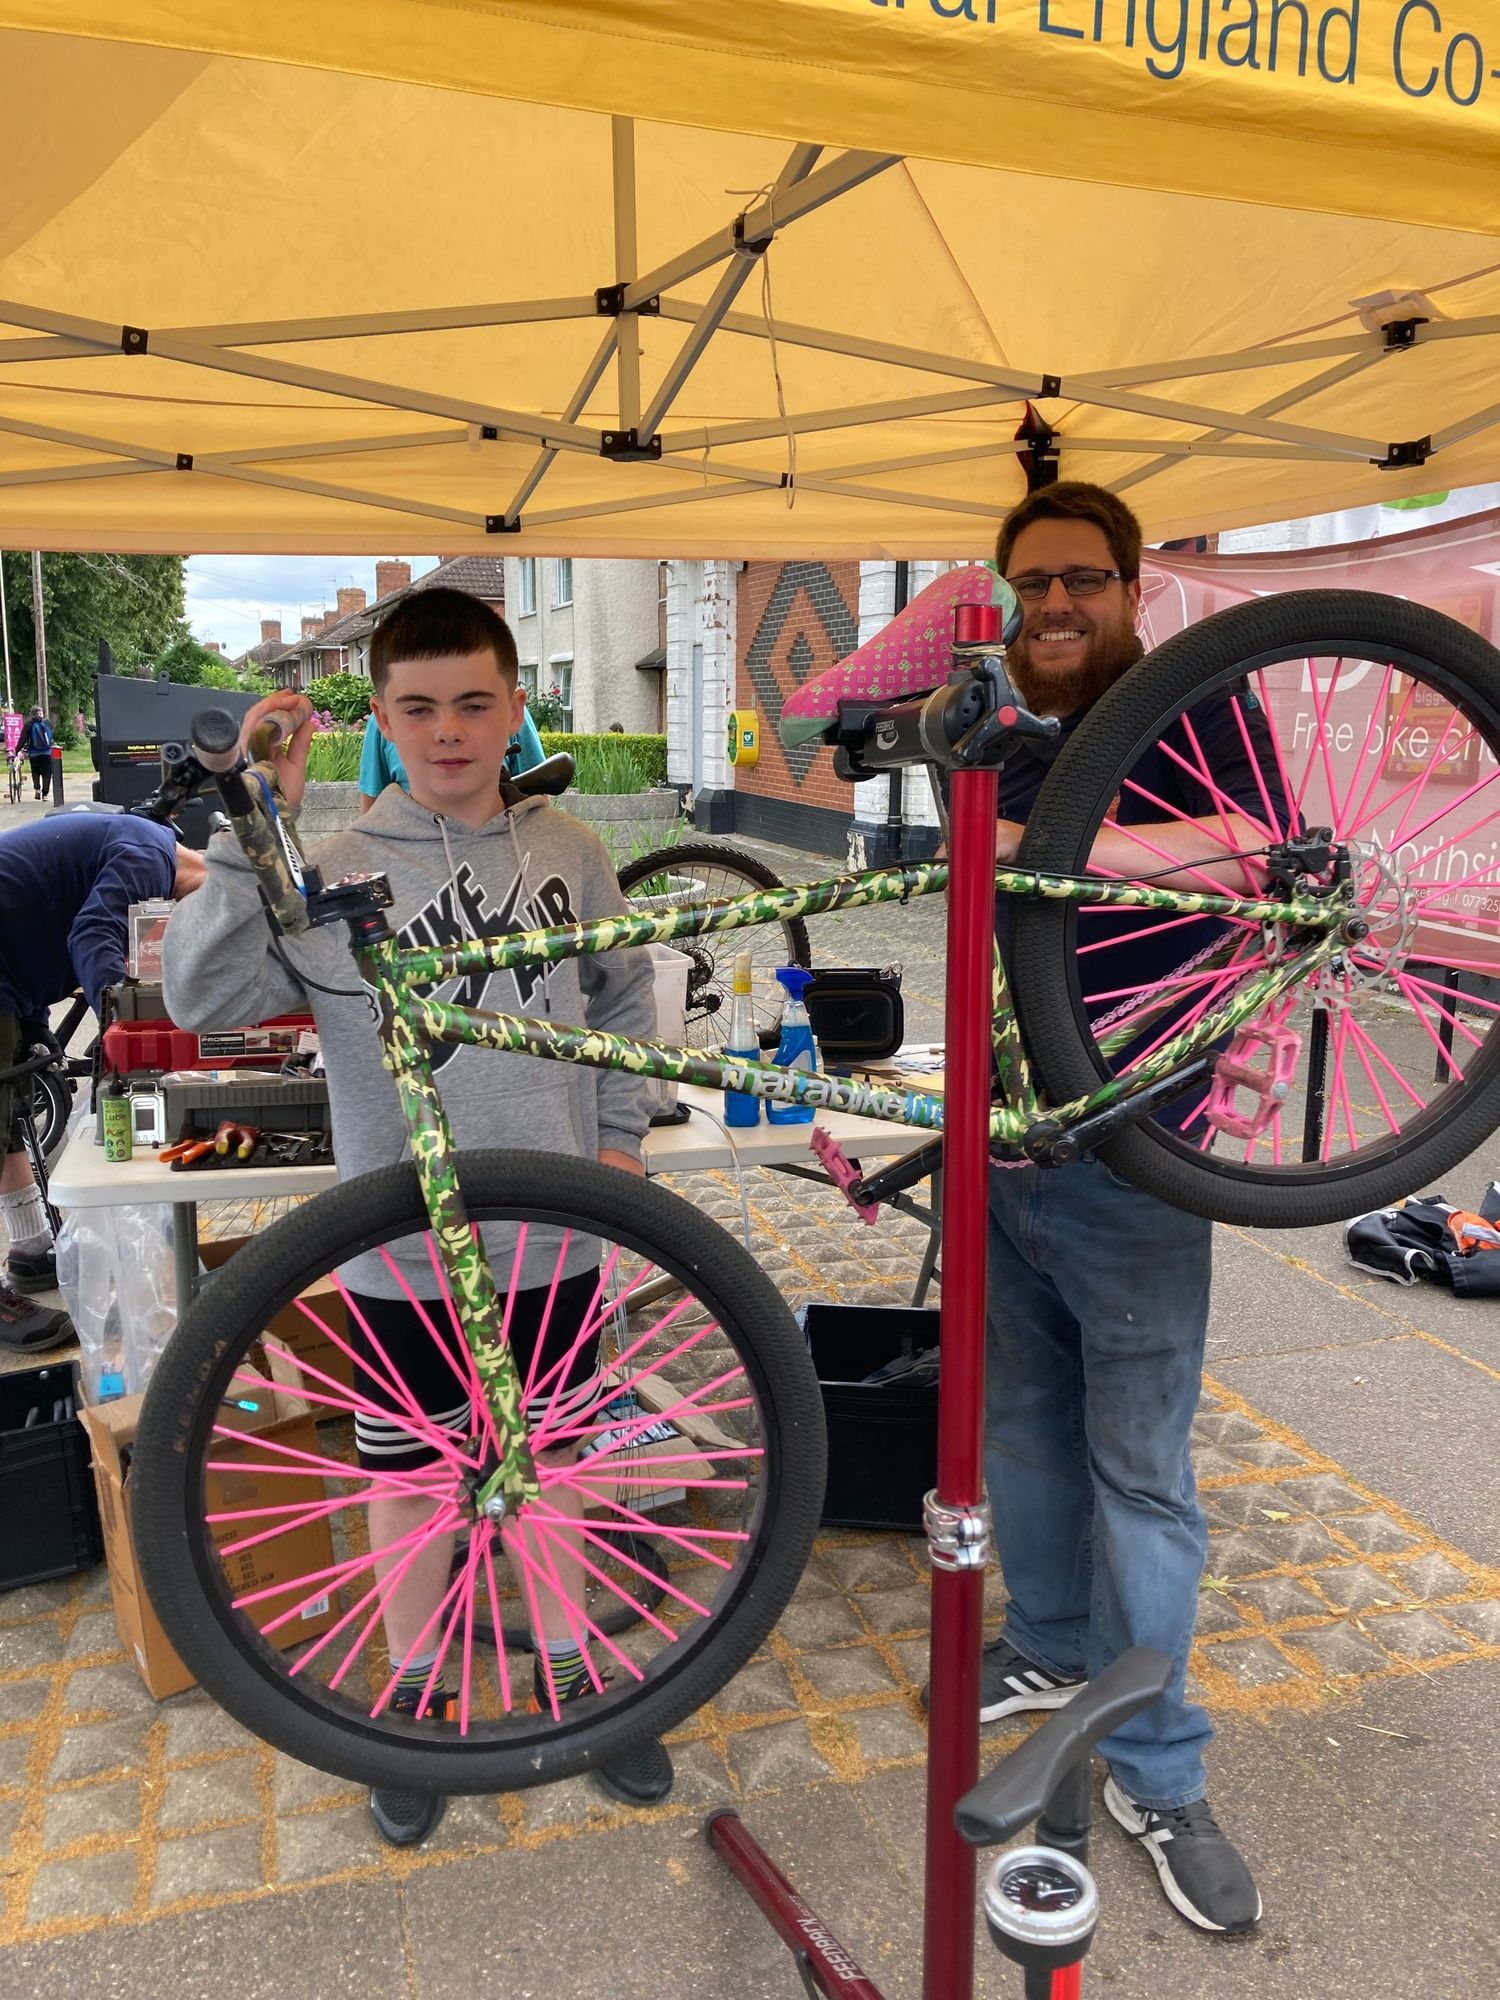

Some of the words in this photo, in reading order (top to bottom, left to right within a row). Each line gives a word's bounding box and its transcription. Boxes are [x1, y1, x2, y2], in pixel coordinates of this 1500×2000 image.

[1293, 713, 1354, 752] Free
[1365, 716, 1430, 759] bike
[1441, 721, 1498, 764] ch
[1370, 827, 1500, 888] Northsi
[796, 1917, 866, 1980] FEEDBACK
